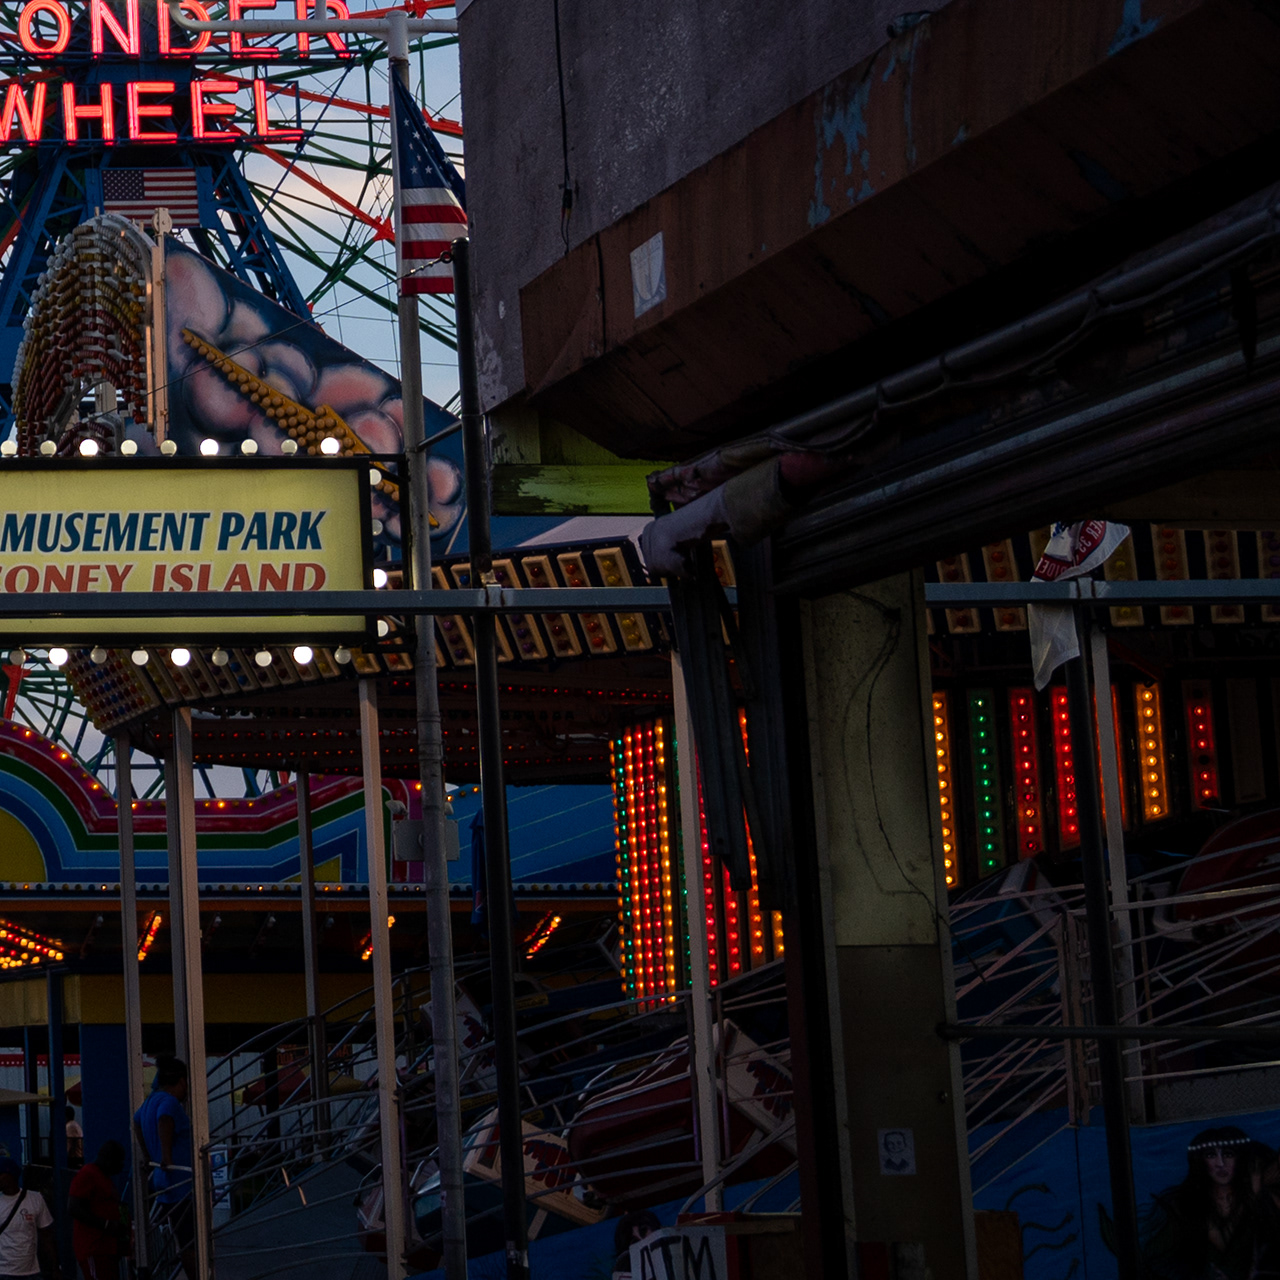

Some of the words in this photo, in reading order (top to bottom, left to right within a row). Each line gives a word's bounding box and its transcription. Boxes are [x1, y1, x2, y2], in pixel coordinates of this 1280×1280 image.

[218, 510, 326, 551] PARK
[150, 563, 327, 593] ISLAND
[640, 1235, 718, 1280] ATM
